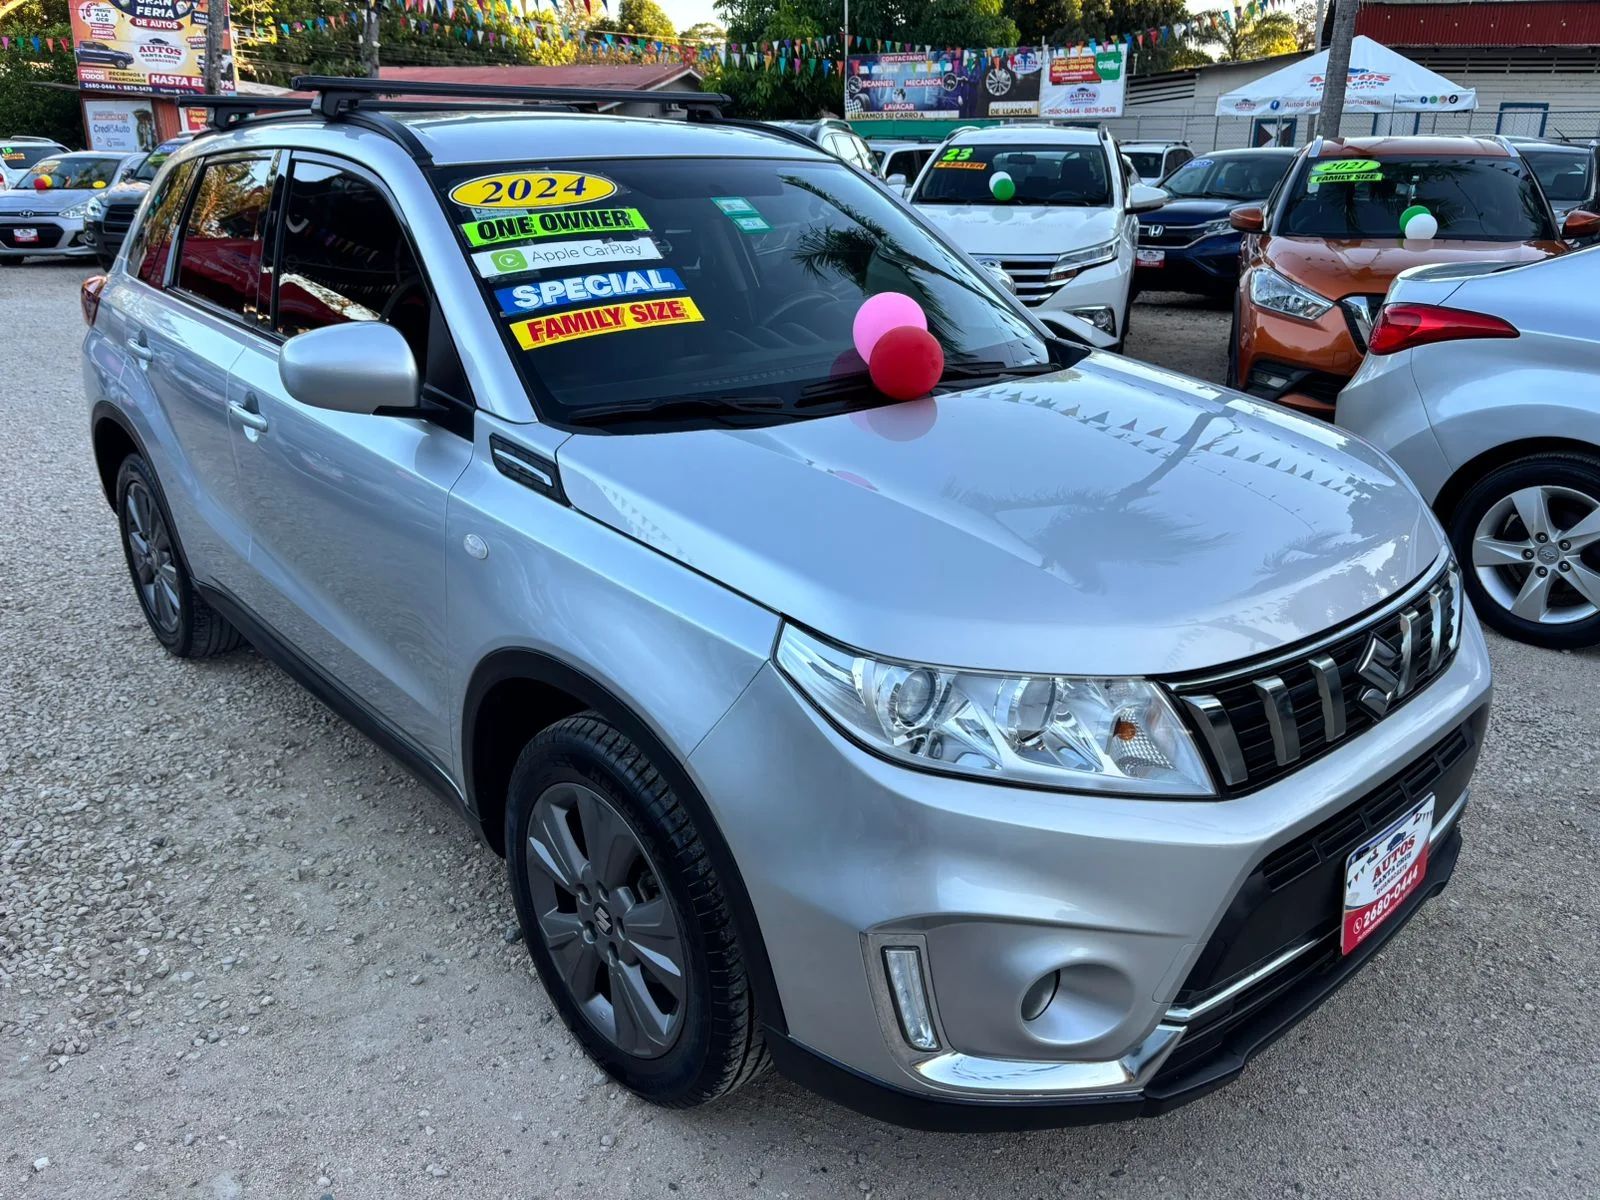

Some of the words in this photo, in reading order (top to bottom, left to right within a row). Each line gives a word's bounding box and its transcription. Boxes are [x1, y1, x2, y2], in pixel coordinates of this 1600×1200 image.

[136, 6, 175, 18] FERIA
[150, 20, 178, 29] AUTOS
[139, 45, 182, 55] AUTOS
[151, 74, 189, 86] HASTA
[191, 77, 205, 87] EL
[862, 80, 894, 88] SCANNER
[884, 103, 915, 111] LAVACAR
[942, 147, 974, 161] 23
[1323, 161, 1369, 171] 2021
[1316, 174, 1354, 182] FAMILY
[1354, 173, 1378, 181] SIZE
[480, 176, 587, 204] 2024
[477, 216, 535, 241] ONE
[538, 210, 632, 232] OWNER
[532, 247, 580, 264] Apple
[583, 243, 643, 258] CarPlay
[512, 269, 674, 309] SPECIAL
[526, 306, 625, 343] FAMILY
[629, 300, 690, 324] SIZE
[1372, 835, 1415, 882] AUTOS
[1373, 865, 1395, 890] SANTA
[1396, 850, 1412, 870] CRUZ
[1363, 864, 1419, 929] 2680-0444
